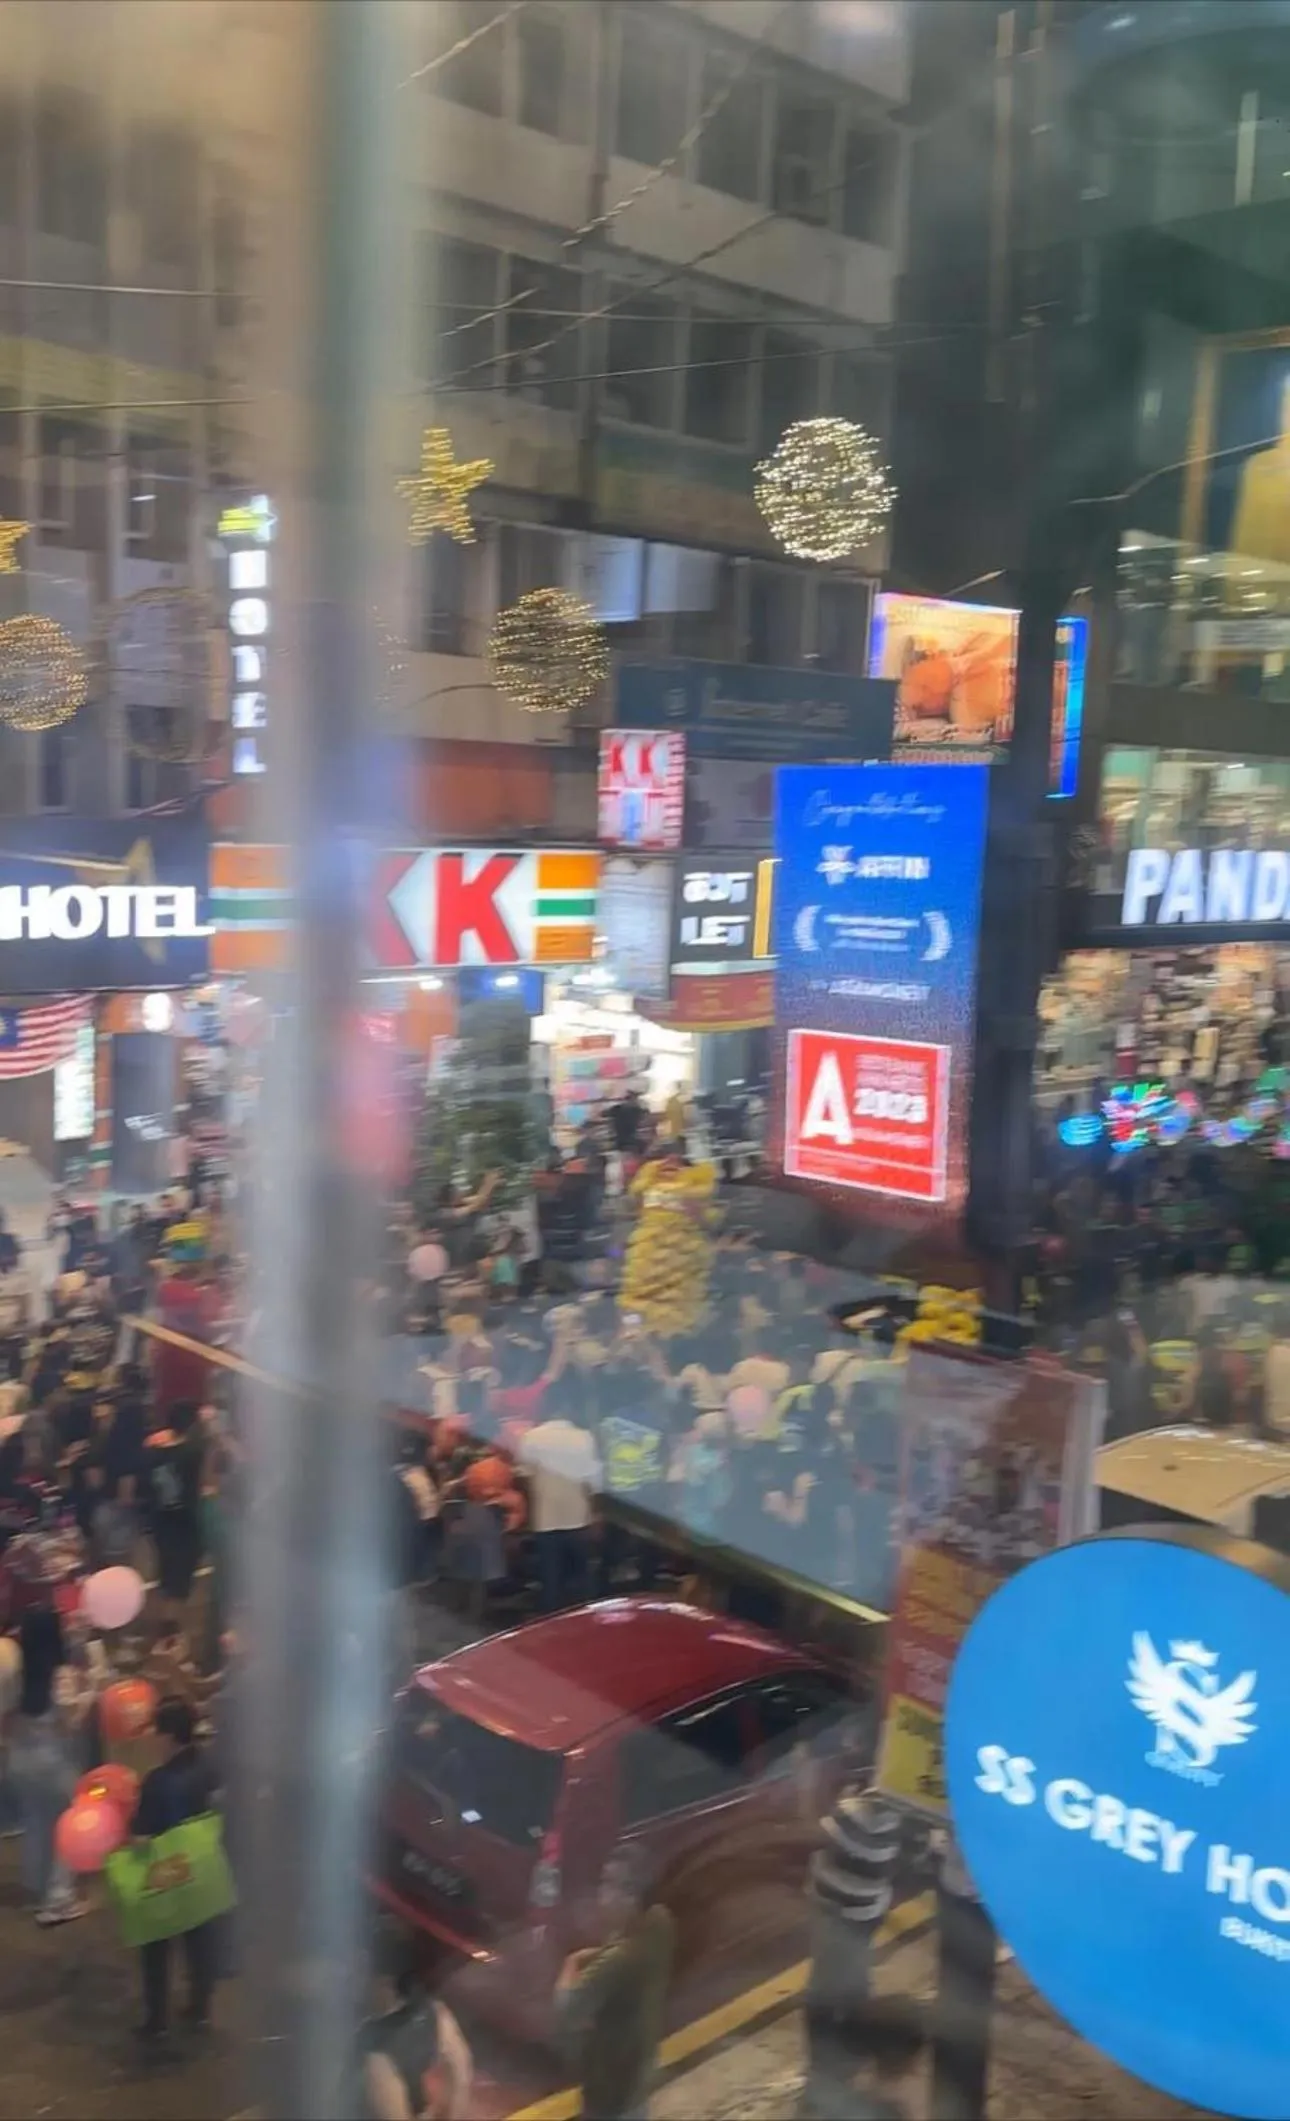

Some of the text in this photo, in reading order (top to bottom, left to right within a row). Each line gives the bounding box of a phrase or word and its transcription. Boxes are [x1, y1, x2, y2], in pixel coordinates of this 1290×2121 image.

[0, 885, 216, 940] HOTEL
[1121, 849, 1290, 925] PAND
[800, 1050, 854, 1145] A
[974, 1745, 1036, 1806] SS
[1044, 1778, 1198, 1873] GREY
